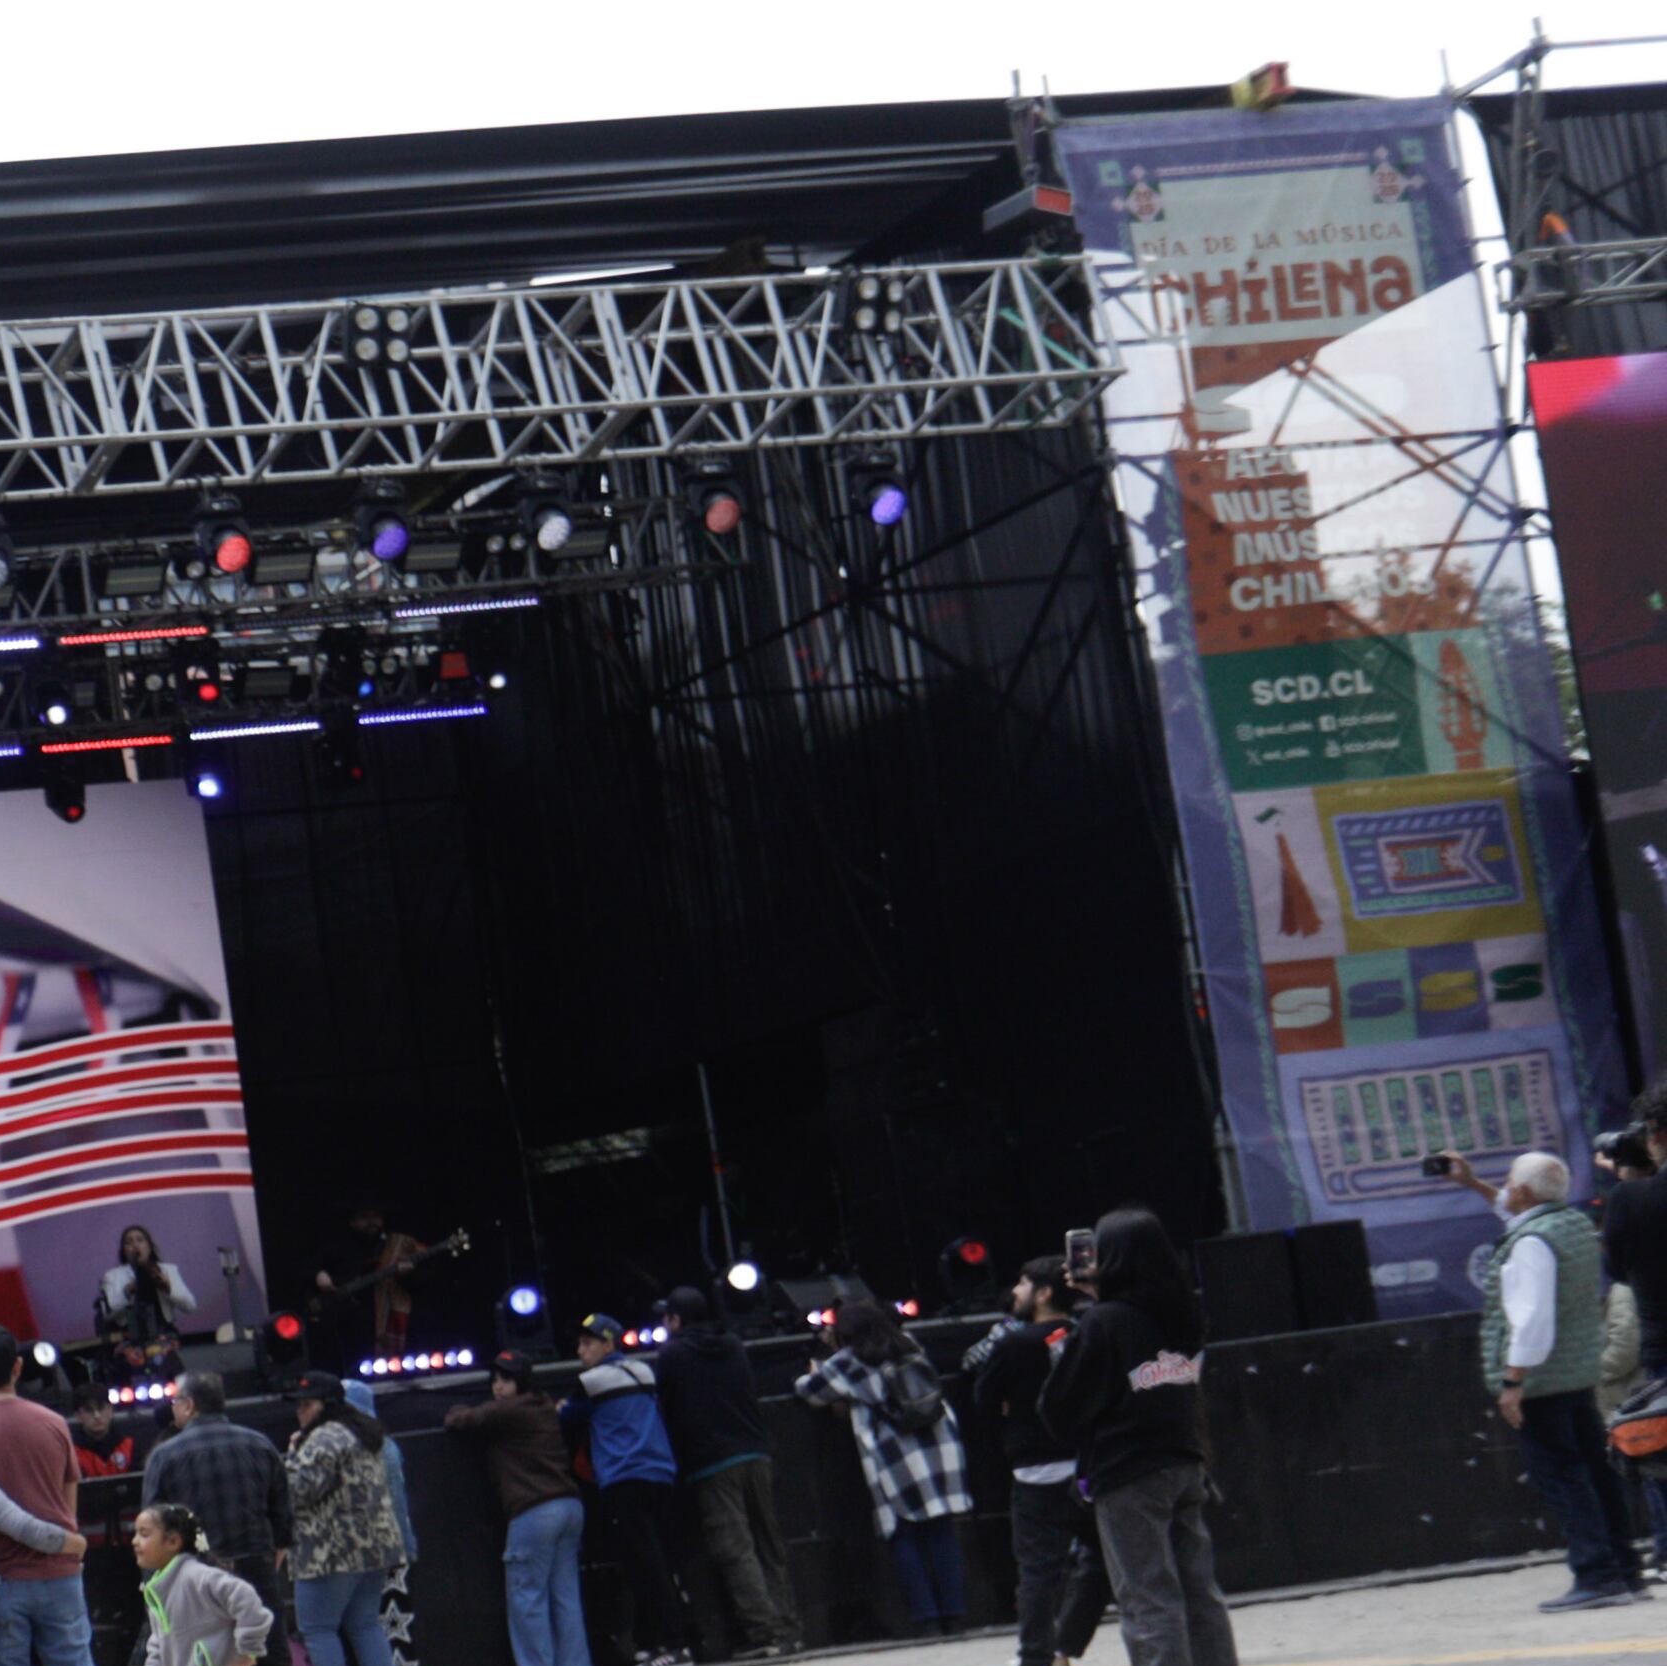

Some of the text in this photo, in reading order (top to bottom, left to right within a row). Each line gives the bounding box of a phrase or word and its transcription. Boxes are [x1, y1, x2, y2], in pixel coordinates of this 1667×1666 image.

[1203, 234, 1236, 255] DE
[1253, 229, 1282, 250] LA
[1295, 221, 1404, 246] MÚSICA
[1251, 669, 1374, 706] SCD.CL
